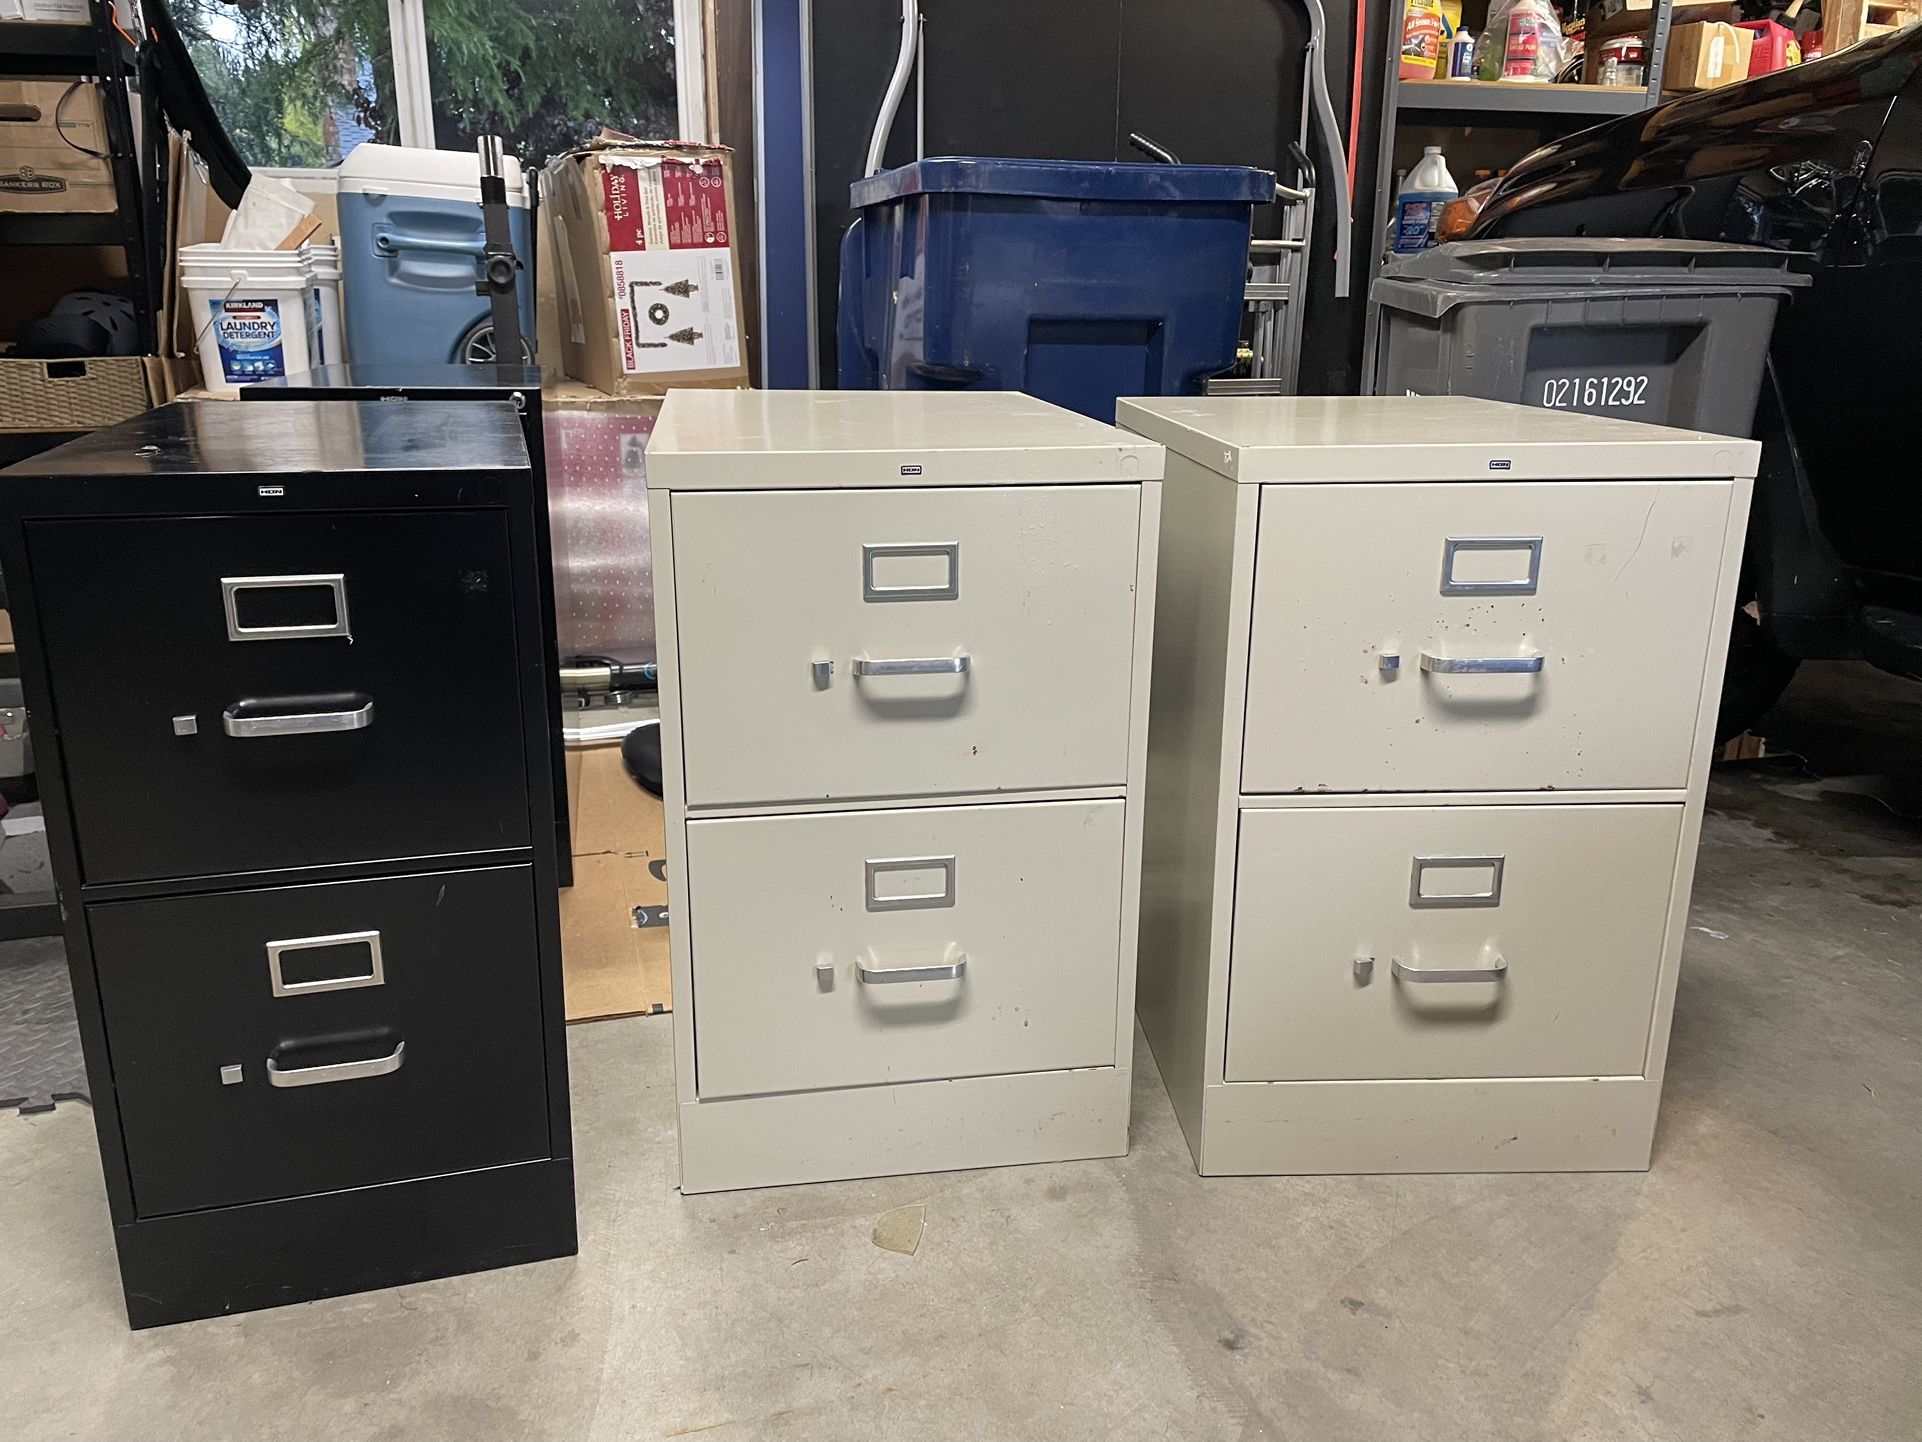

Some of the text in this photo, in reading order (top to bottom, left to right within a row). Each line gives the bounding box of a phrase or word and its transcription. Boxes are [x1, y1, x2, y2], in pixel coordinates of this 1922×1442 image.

[609, 174, 623, 221] HOLIDAY
[619, 176, 629, 216] LIVING
[220, 321, 276, 331] LAUNDRY
[223, 331, 276, 340] DETERGENT
[621, 310, 635, 369] BLACK FRIDAY
[1542, 375, 1649, 407] 02161292
